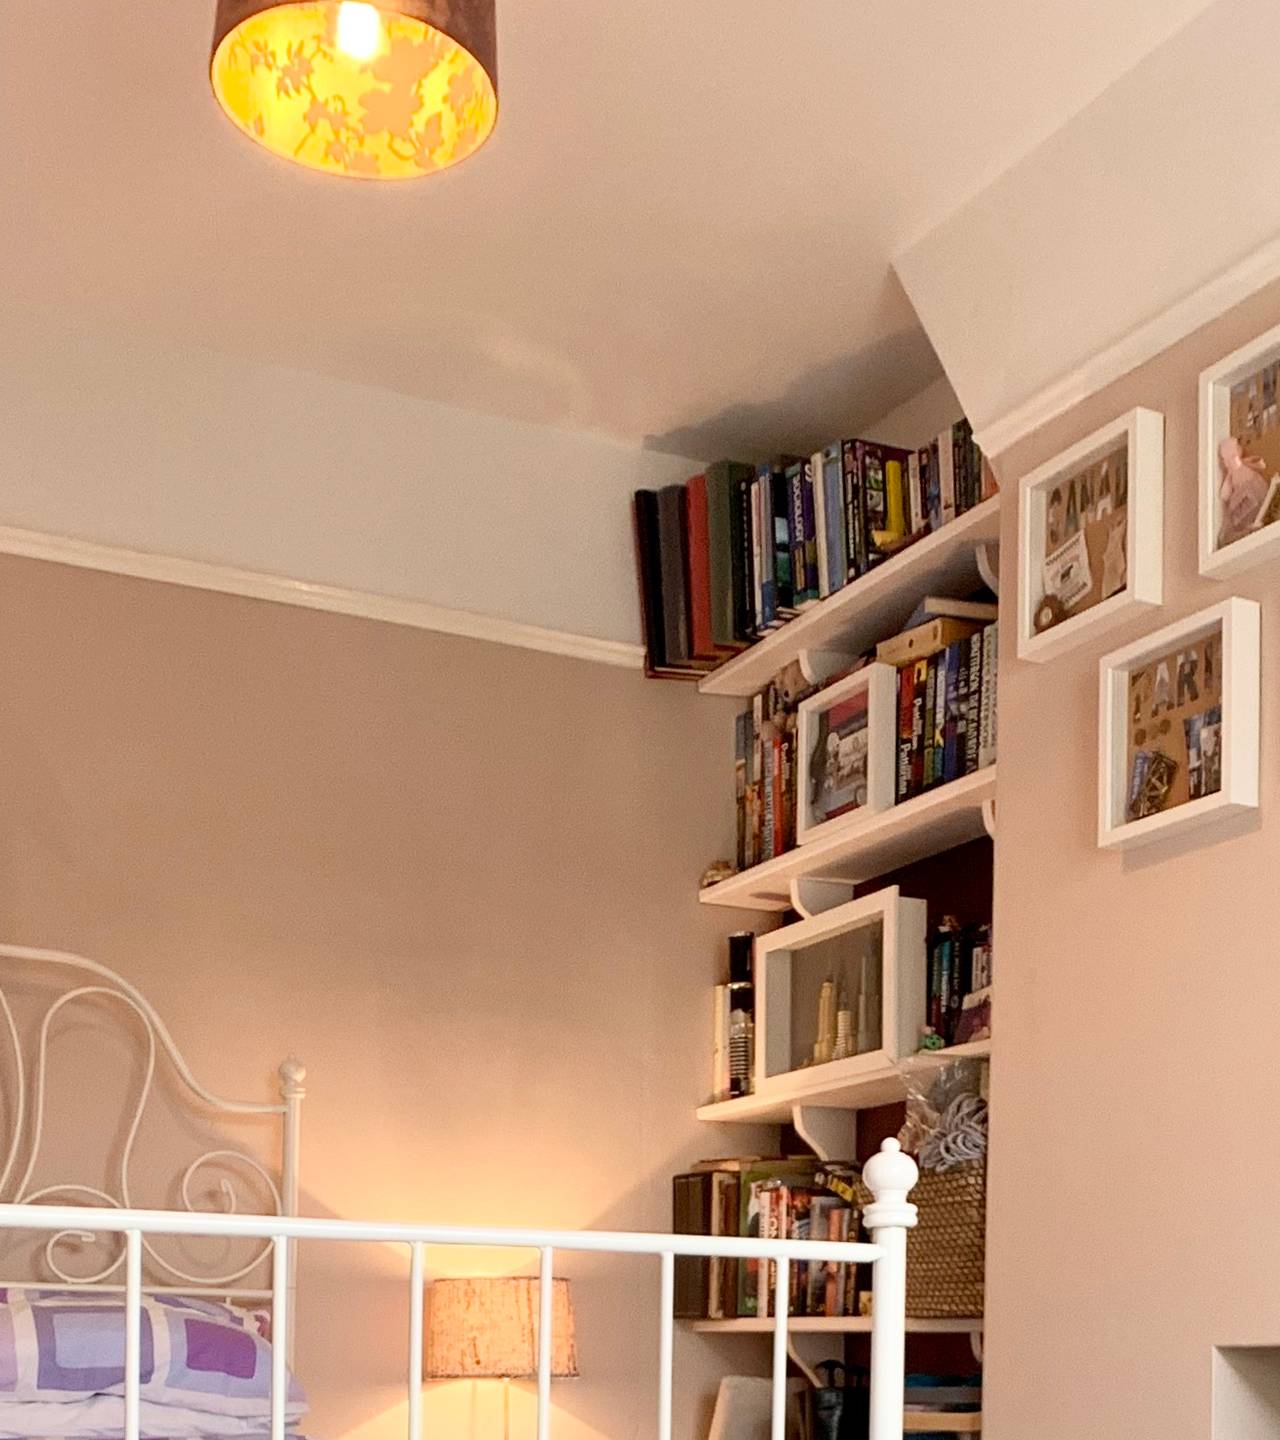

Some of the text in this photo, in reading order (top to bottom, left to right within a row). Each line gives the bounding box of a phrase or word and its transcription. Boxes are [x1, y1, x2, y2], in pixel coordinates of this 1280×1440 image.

[792, 473, 805, 542] SOCIOLOGY
[1131, 638, 1216, 723] PARI
[899, 742, 912, 795] Patterson
